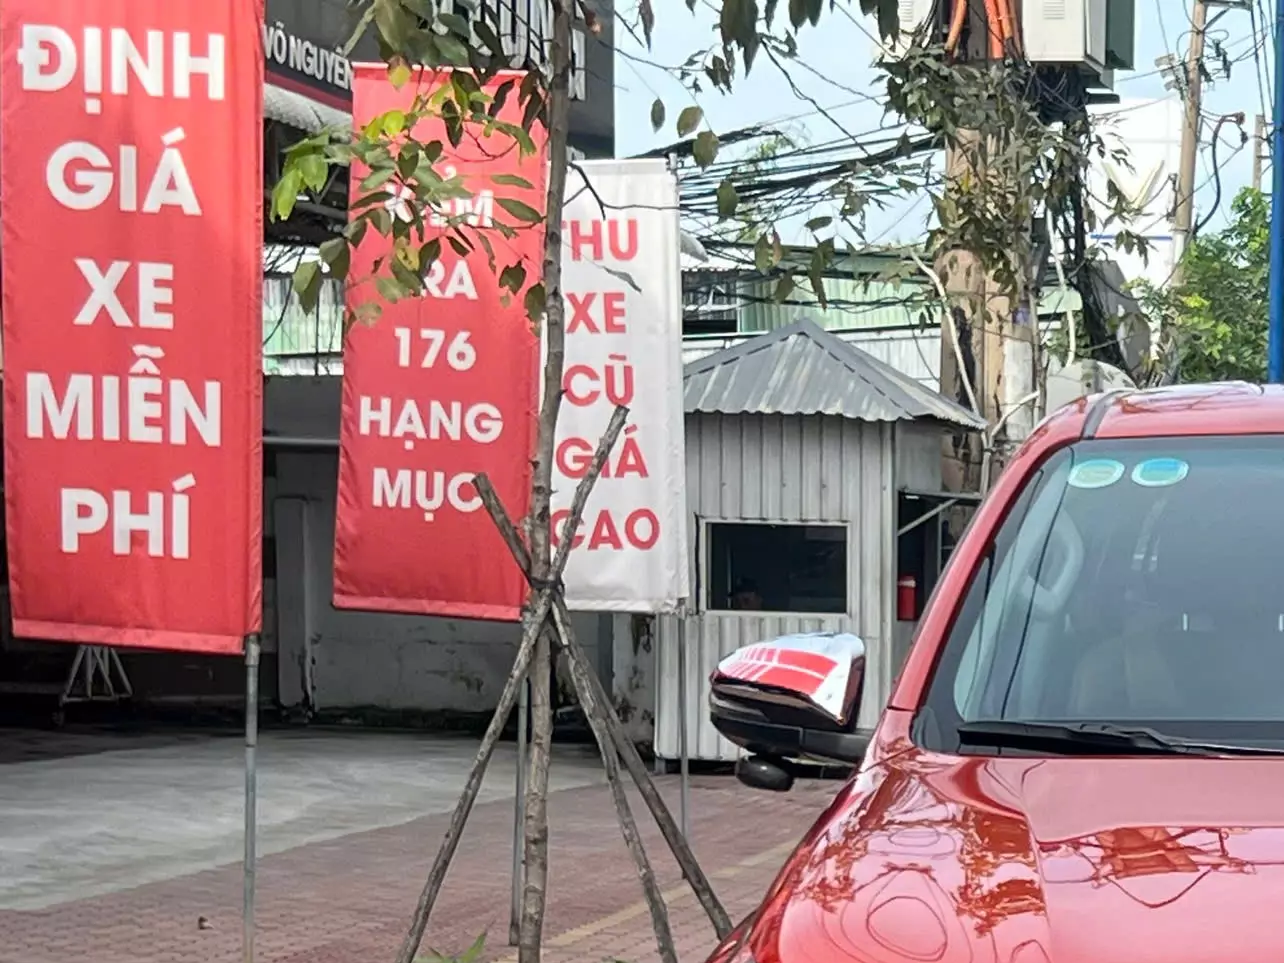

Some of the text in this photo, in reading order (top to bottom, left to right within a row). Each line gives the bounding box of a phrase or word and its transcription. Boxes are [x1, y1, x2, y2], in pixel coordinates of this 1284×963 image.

[17, 24, 225, 115] ĐỊNH
[263, 21, 287, 64] VÕ
[46, 126, 203, 216] GIÁ
[562, 219, 639, 261] HU
[73, 257, 175, 330] XE
[565, 292, 627, 334] XE
[394, 327, 477, 371] 176
[26, 344, 221, 446] MIỄN
[562, 354, 634, 406] CŨ
[359, 395, 504, 450] HẠNG
[61, 473, 196, 559] PHÍ
[372, 468, 484, 522] MỤC
